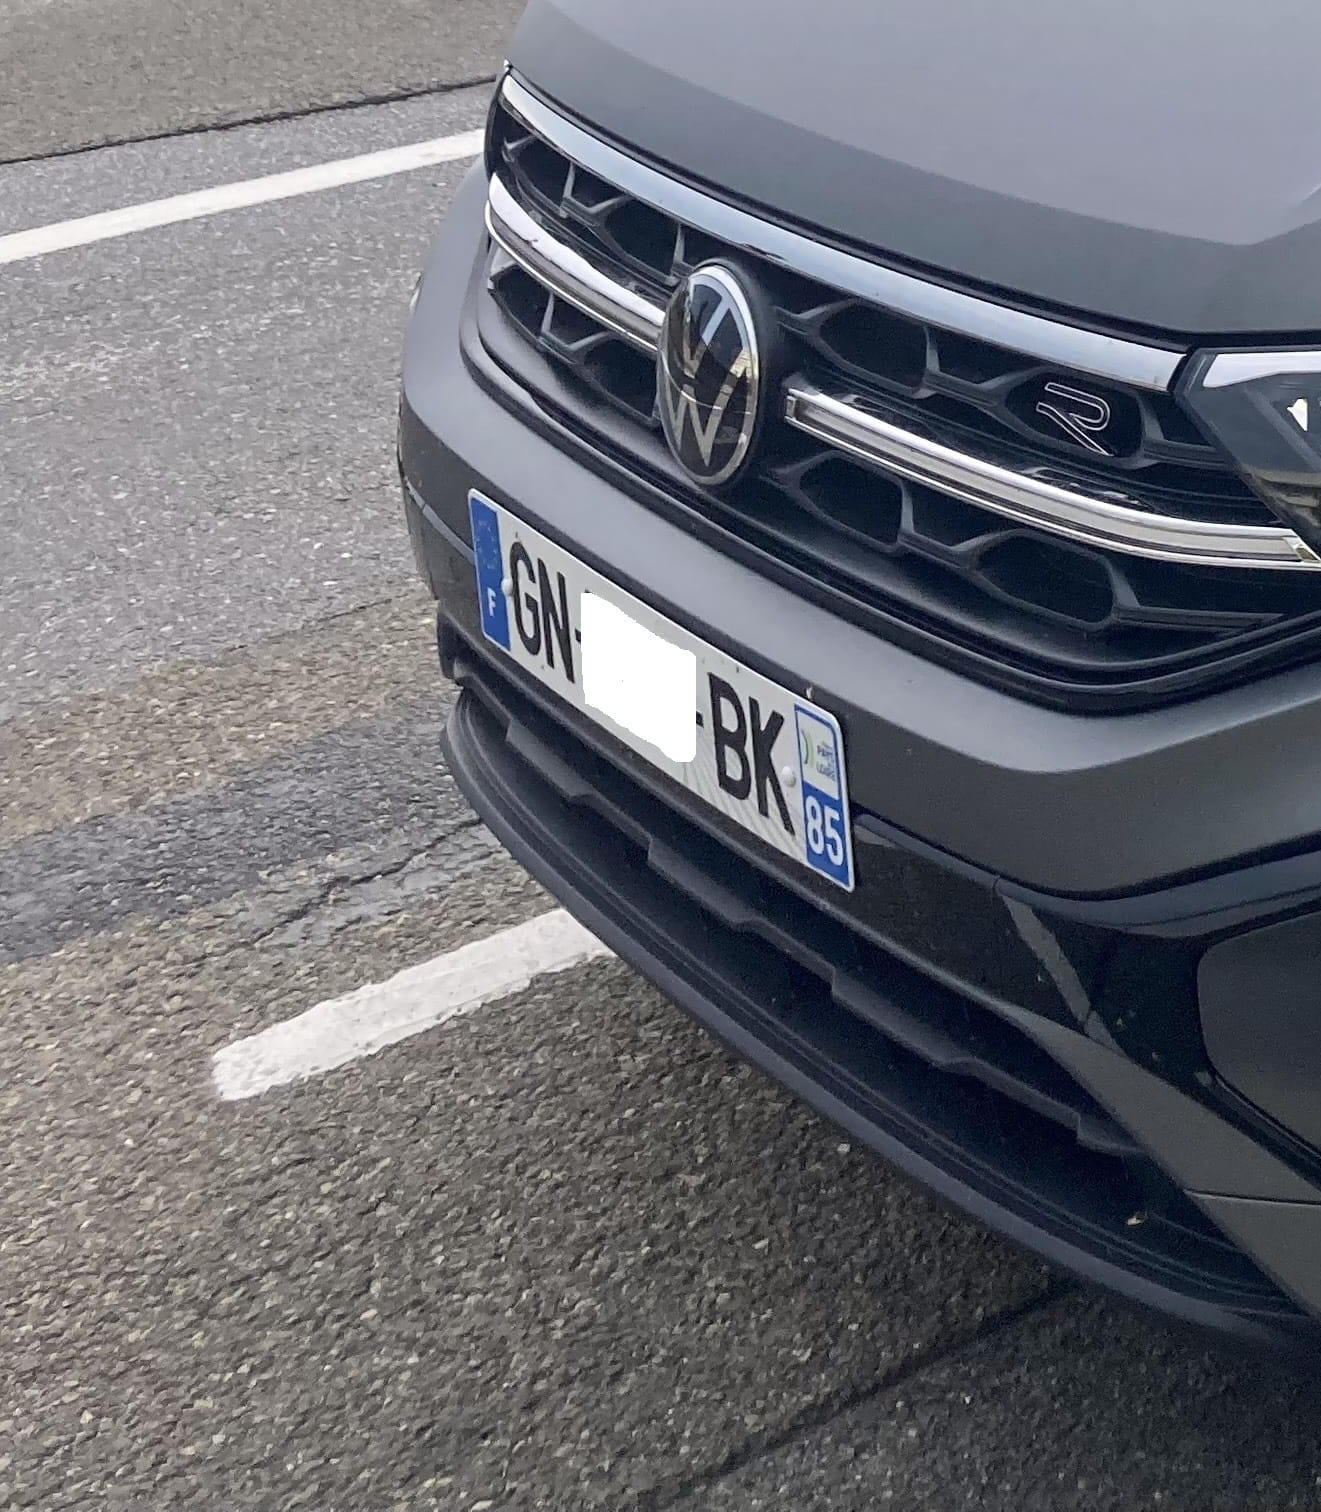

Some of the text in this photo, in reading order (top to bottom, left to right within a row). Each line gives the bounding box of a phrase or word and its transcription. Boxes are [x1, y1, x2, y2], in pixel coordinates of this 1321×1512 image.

[1036, 382, 1114, 456] R
[487, 587, 497, 617] F
[805, 795, 844, 866] 85
